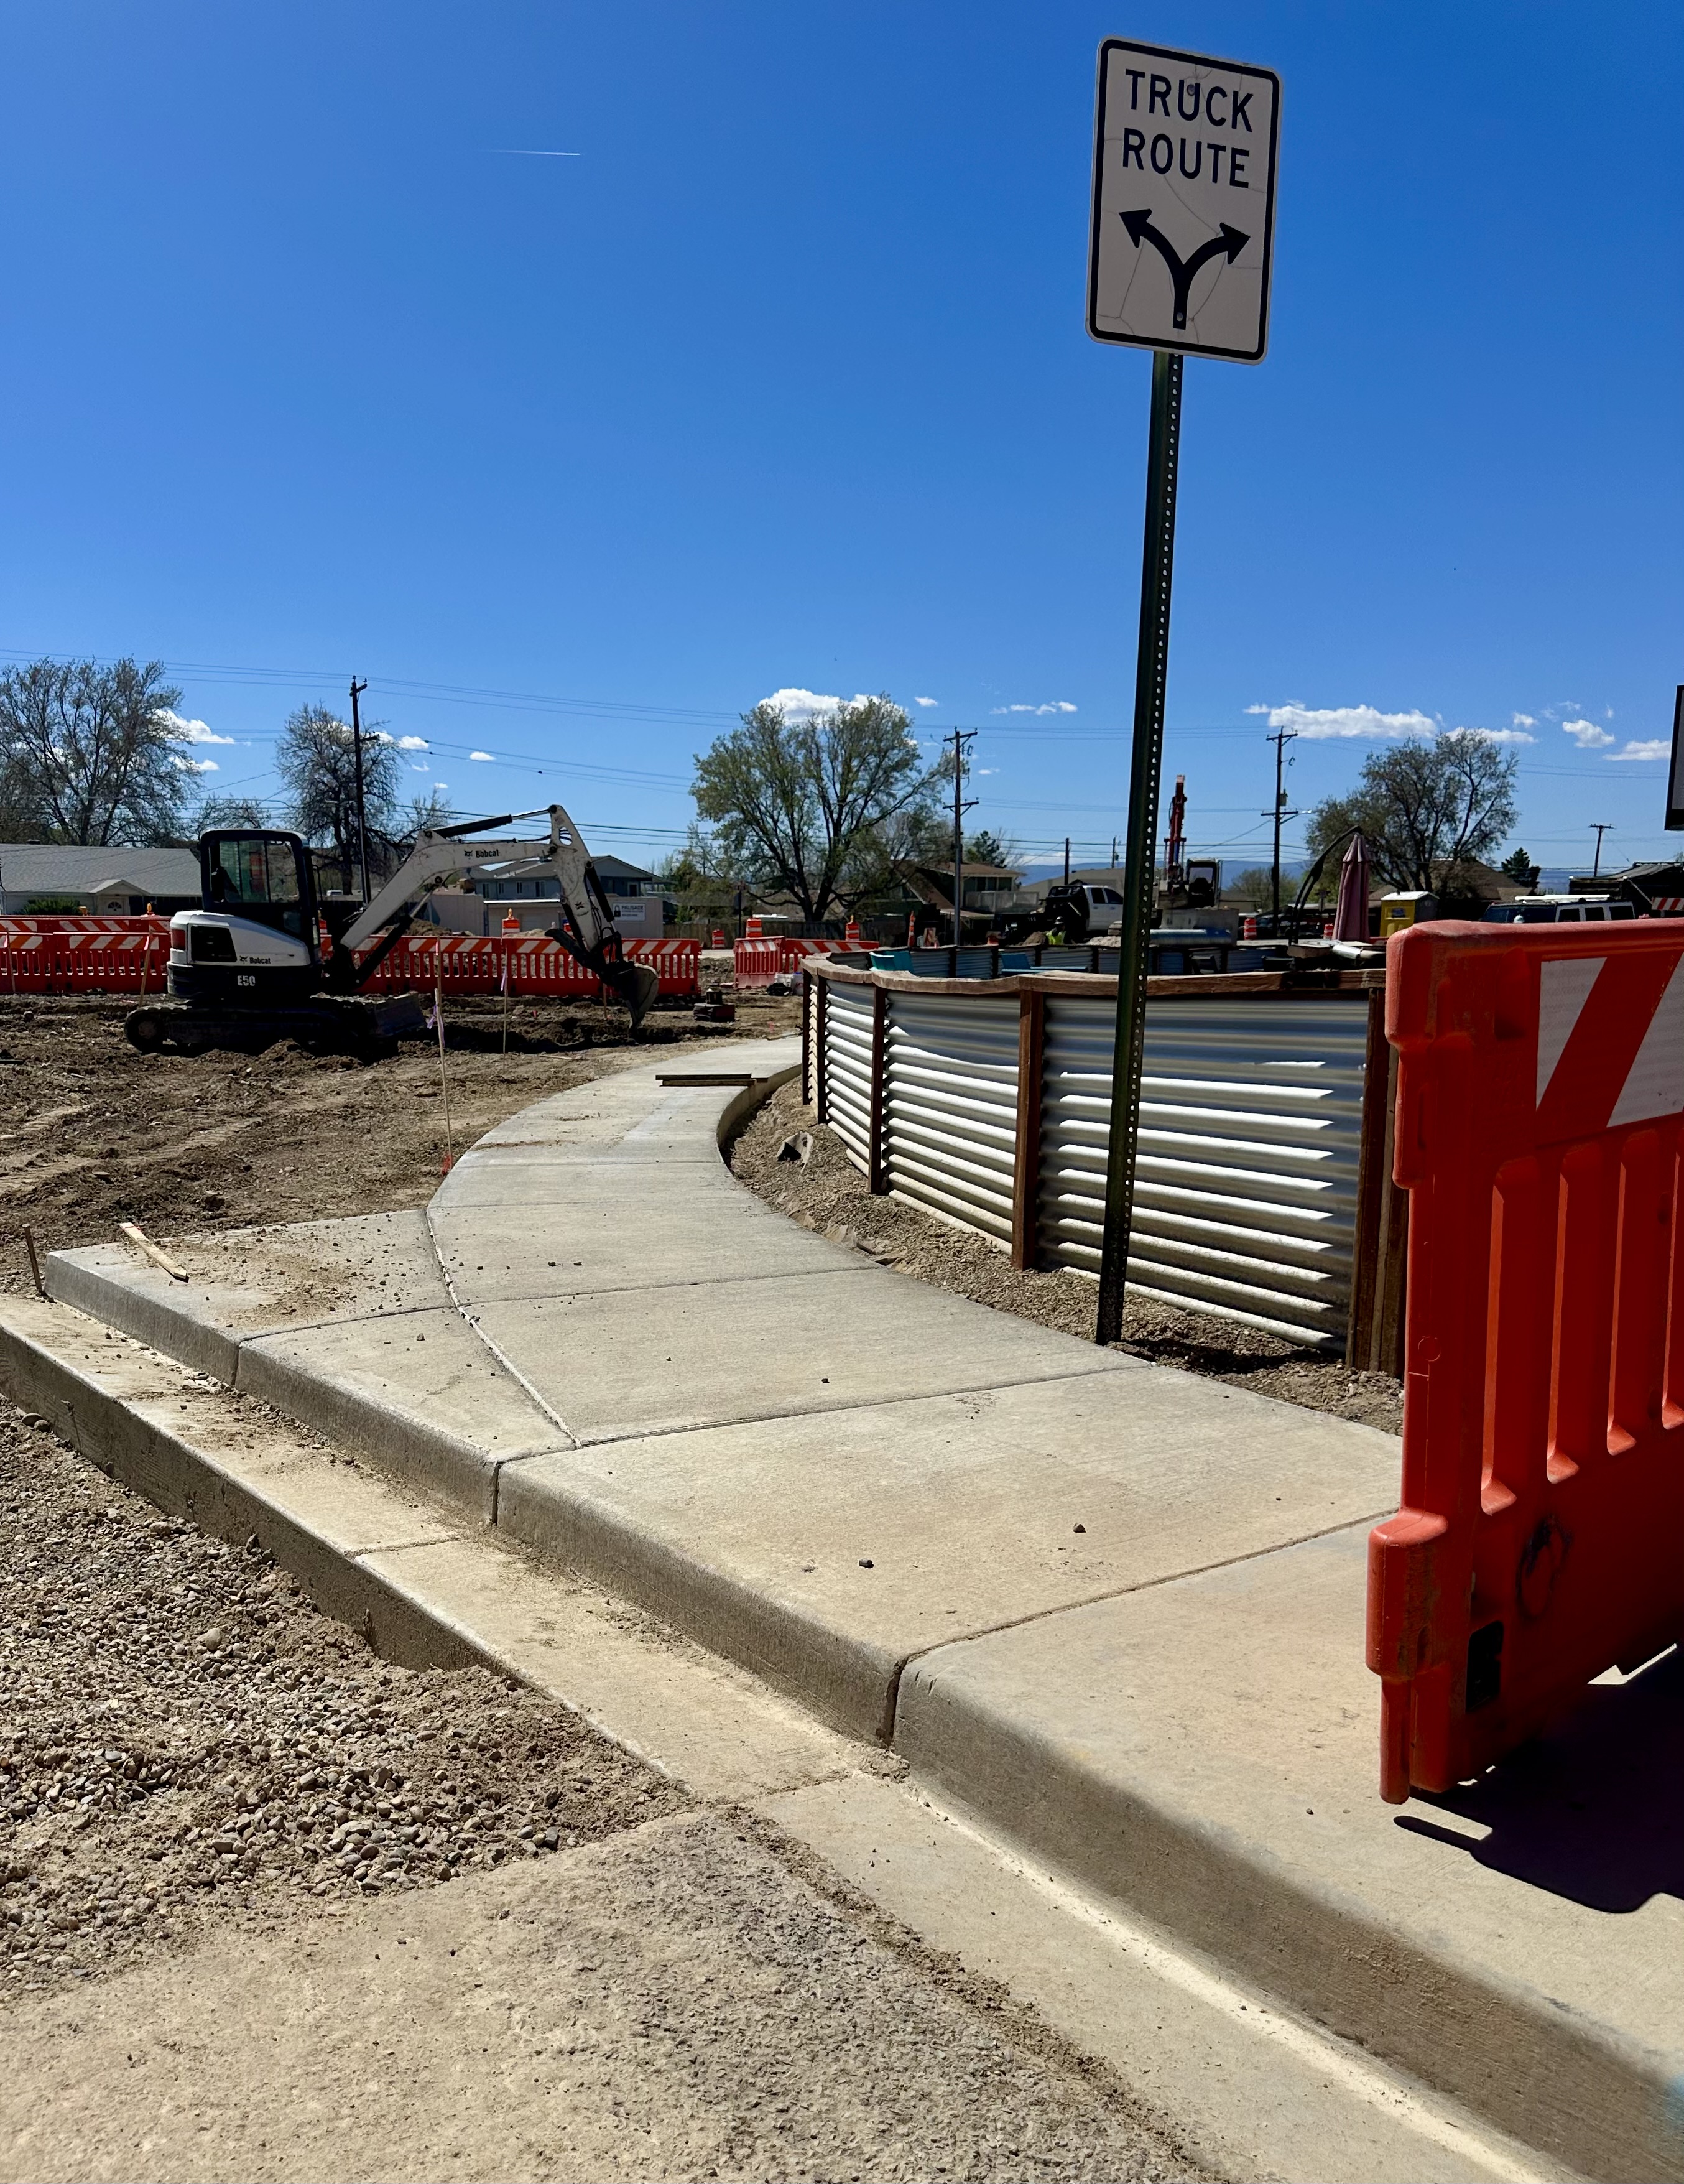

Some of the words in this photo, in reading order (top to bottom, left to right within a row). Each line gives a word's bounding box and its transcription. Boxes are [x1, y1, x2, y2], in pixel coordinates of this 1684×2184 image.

[1125, 69, 1254, 132] TRUCK
[1122, 128, 1250, 188] ROUTE
[476, 849, 499, 858] Bobcat
[237, 975, 256, 986] E50
